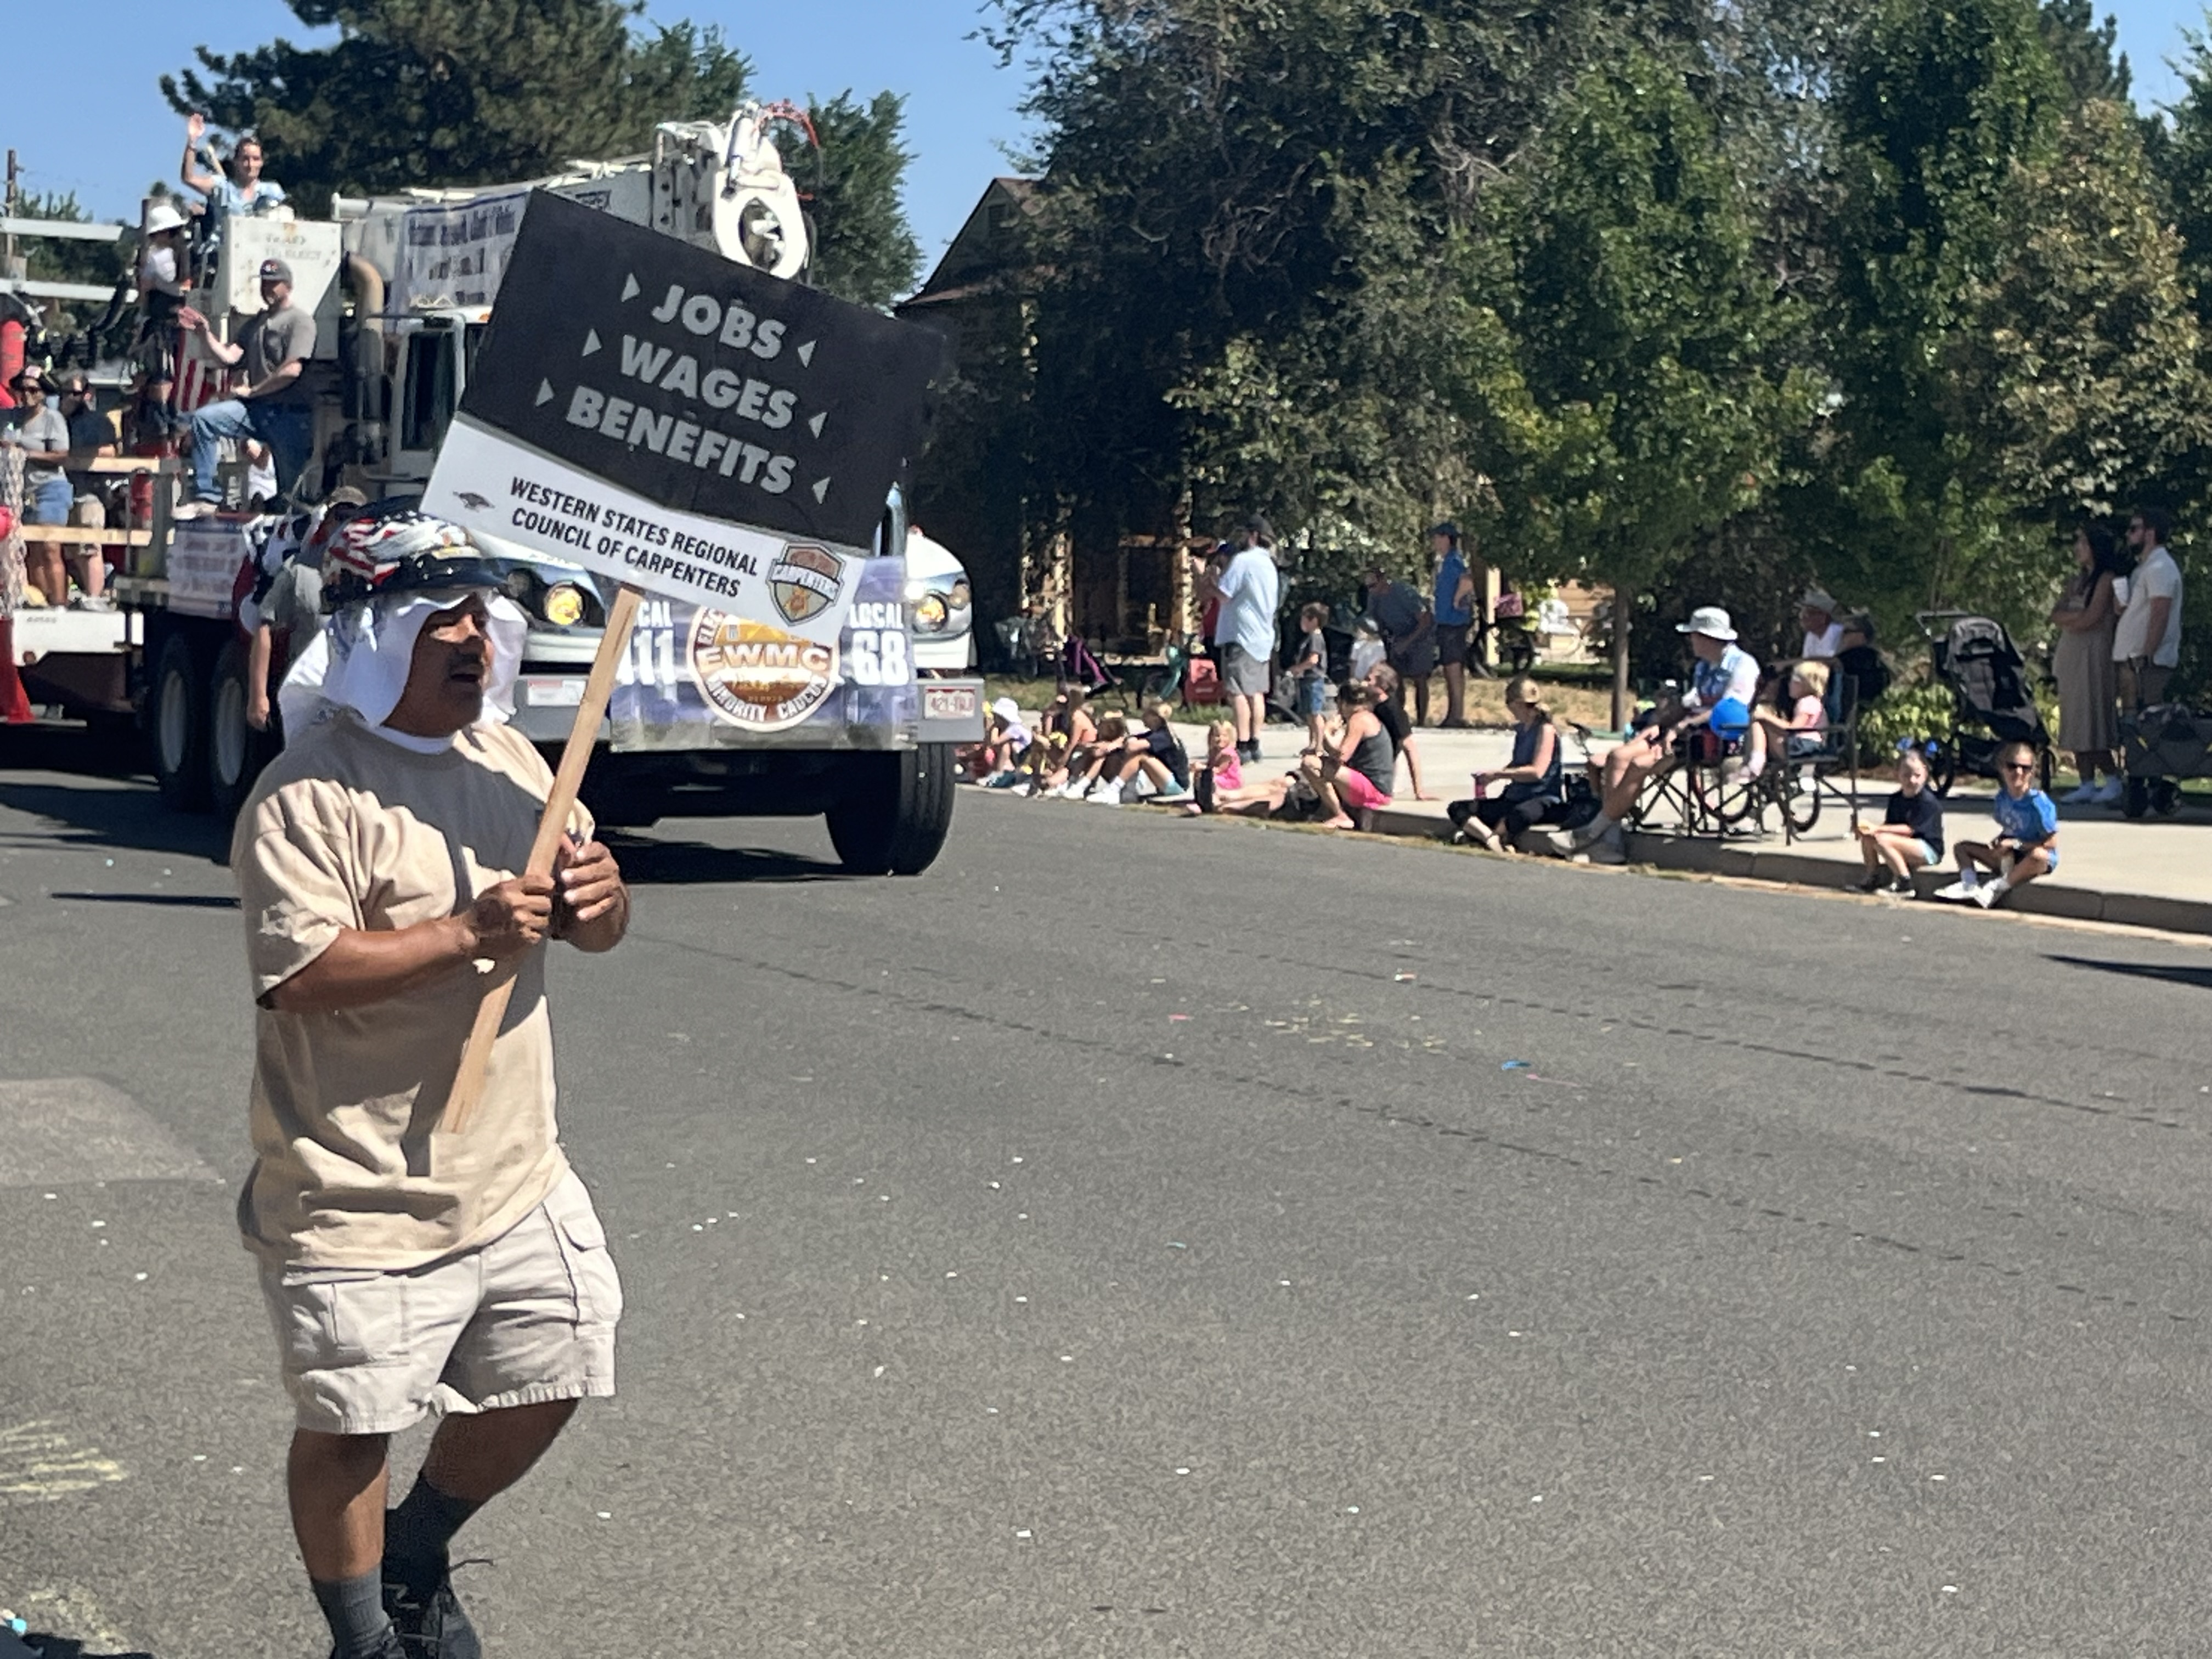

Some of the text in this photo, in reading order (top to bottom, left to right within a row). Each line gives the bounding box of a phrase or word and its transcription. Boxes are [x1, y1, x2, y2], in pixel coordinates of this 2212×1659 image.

[651, 284, 787, 359] JOBS
[620, 334, 798, 430] WAGES
[566, 385, 798, 494] BENEFITS
[510, 476, 601, 522] WESTERN
[602, 509, 670, 546] STATES
[672, 532, 758, 577] REGIONAL
[512, 507, 591, 550] COUNCIL
[597, 536, 624, 560] OF
[625, 545, 741, 598] CARPENTERS
[635, 601, 673, 627] CAL
[850, 602, 904, 629] LOCAL
[696, 644, 828, 673] EWMC
[852, 631, 909, 685] 68
